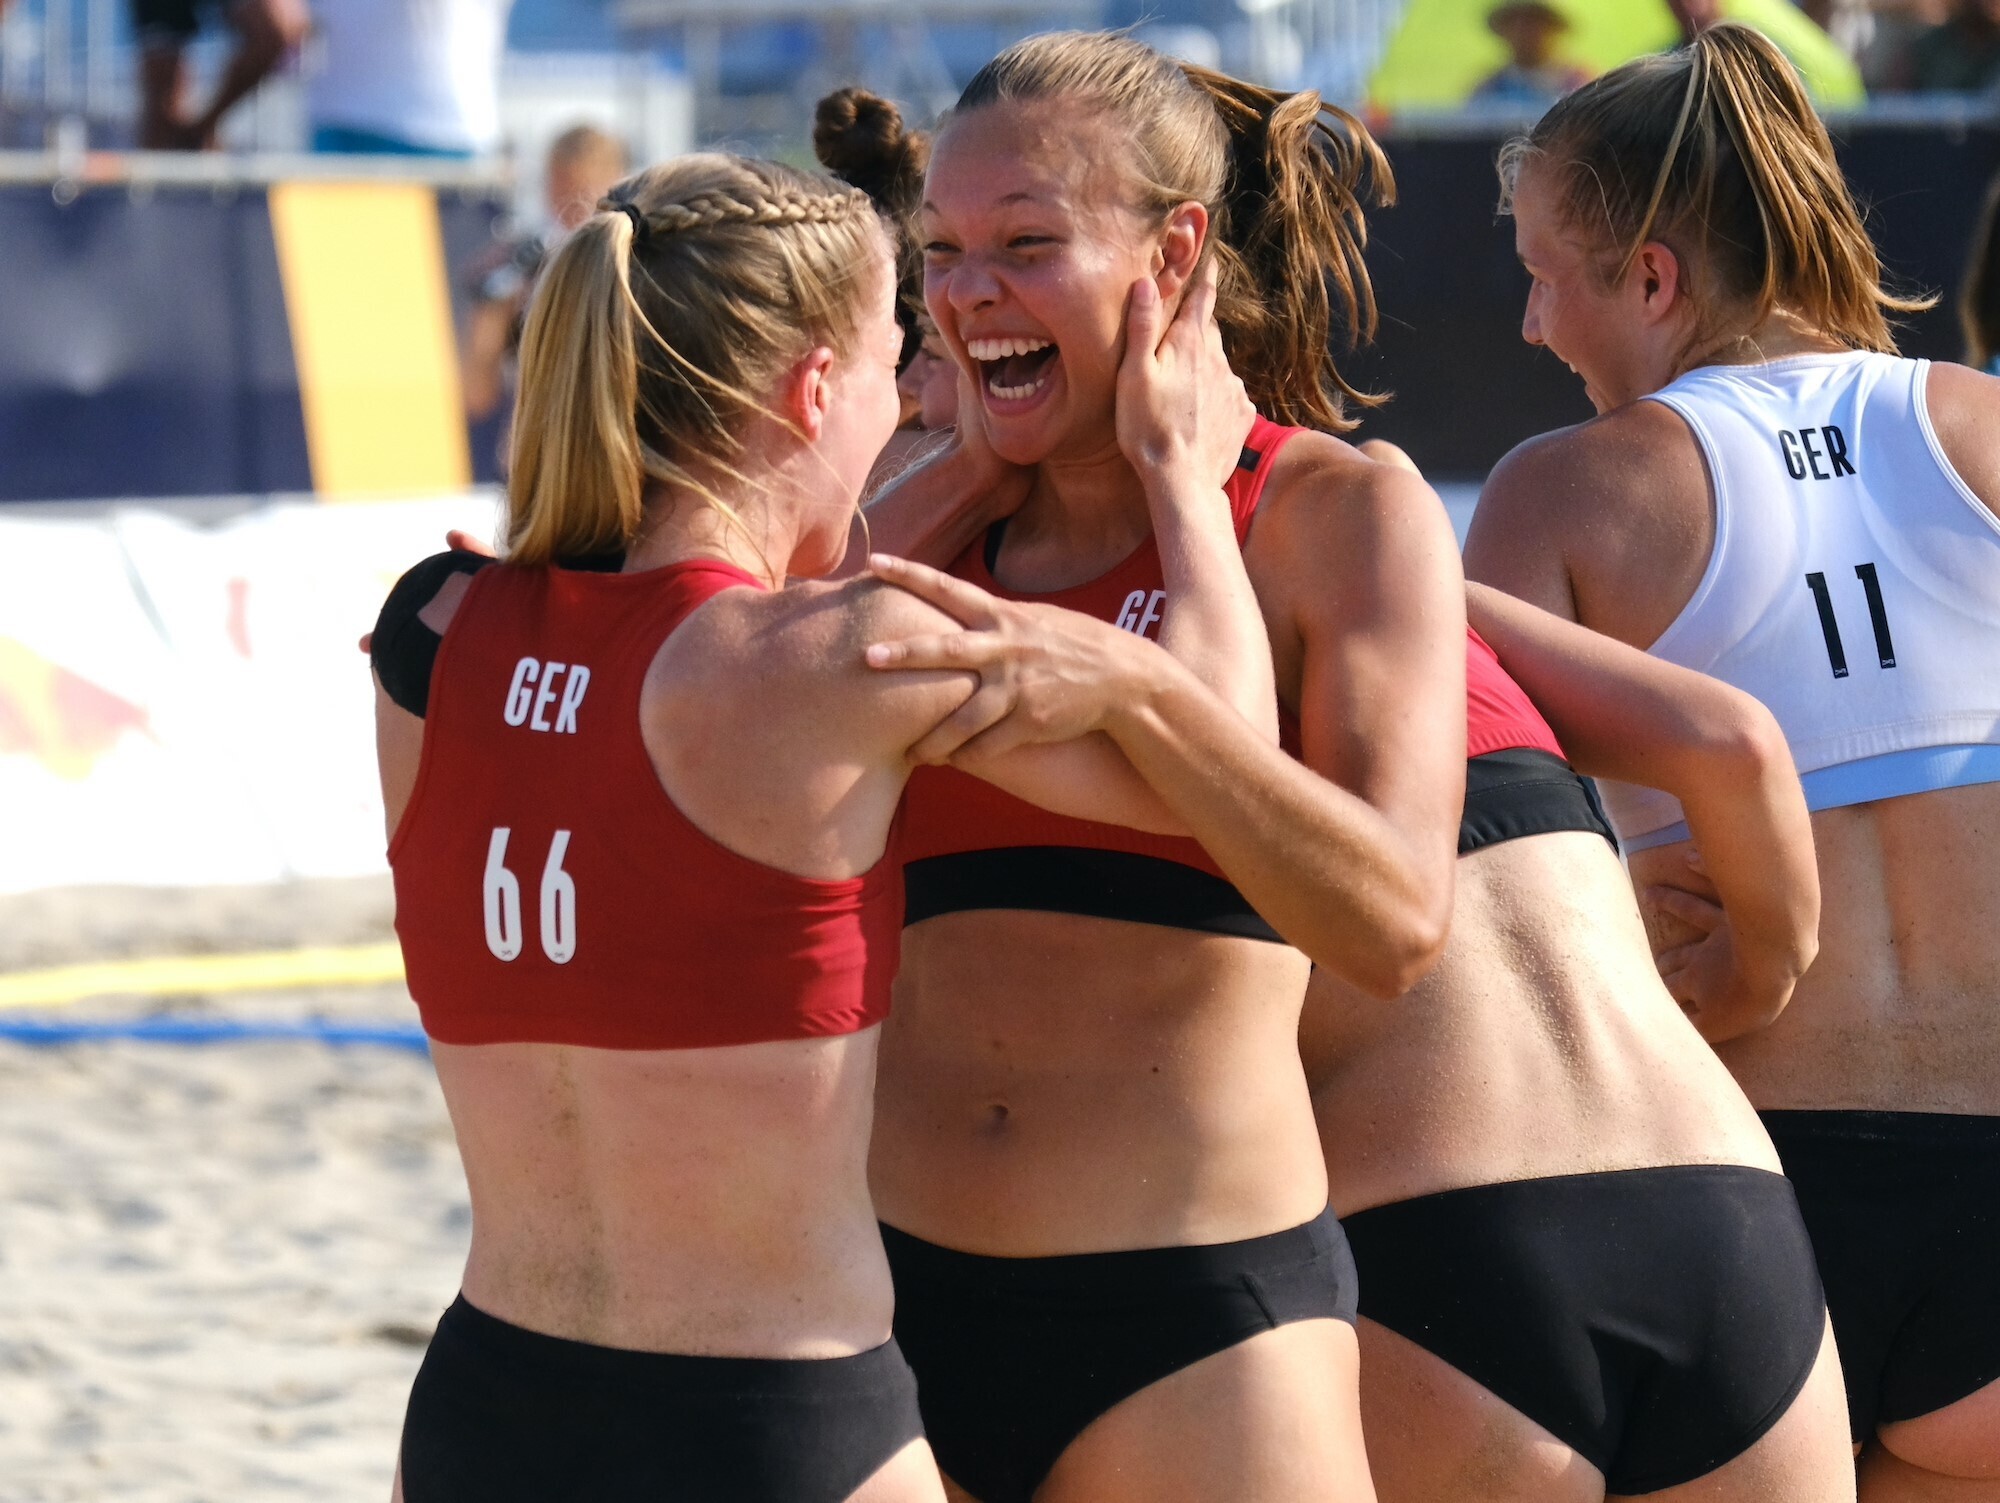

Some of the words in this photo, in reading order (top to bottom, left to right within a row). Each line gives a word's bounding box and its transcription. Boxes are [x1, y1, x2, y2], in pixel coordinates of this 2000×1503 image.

[1778, 425, 1856, 480] GER
[1114, 589, 1167, 641] GE
[1805, 562, 1896, 679] 11
[503, 656, 591, 734] GER
[483, 827, 576, 965] 66
